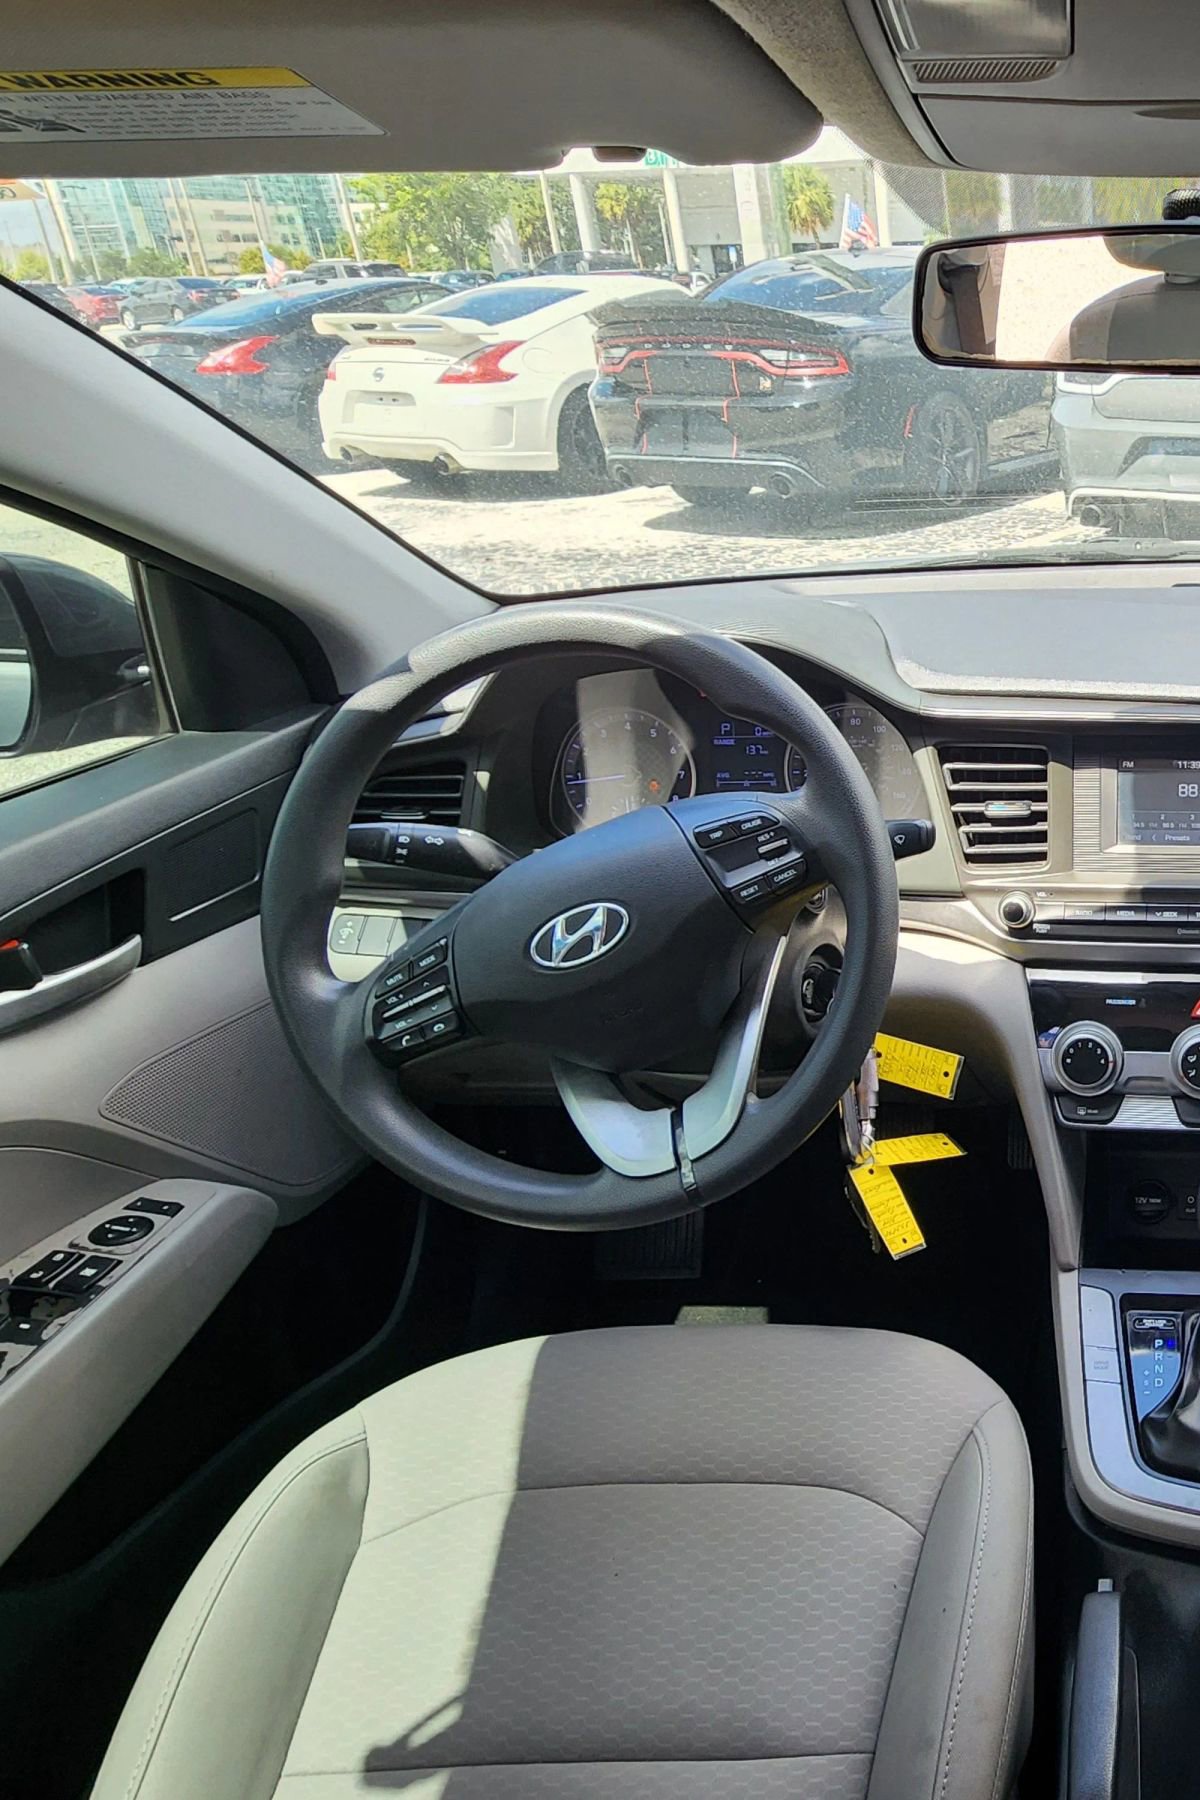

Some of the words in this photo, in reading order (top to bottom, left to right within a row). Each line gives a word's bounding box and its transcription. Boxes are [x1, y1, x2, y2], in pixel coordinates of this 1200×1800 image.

[9, 72, 221, 88] WARNING
[624, 721, 632, 731] 4
[850, 717, 862, 726] 80
[649, 728, 657, 738] 5
[721, 723, 731, 735] P
[872, 725, 887, 733] 100
[670, 745, 677, 754] 6
[746, 744, 763, 755] 137
[1122, 761, 1134, 769] FM
[1177, 760, 1200, 770] 11:39
[709, 830, 724, 840] TRIP
[1165, 832, 1191, 842] Presets
[773, 868, 798, 883] CANCEL
[740, 884, 760, 898] RESET
[419, 955, 437, 967] MODE
[386, 973, 403, 986] MUTE
[1154, 1339, 1164, 1349] P
[1154, 1352, 1164, 1361] R
[1154, 1364, 1164, 1374] N
[1154, 1377, 1164, 1388] D
